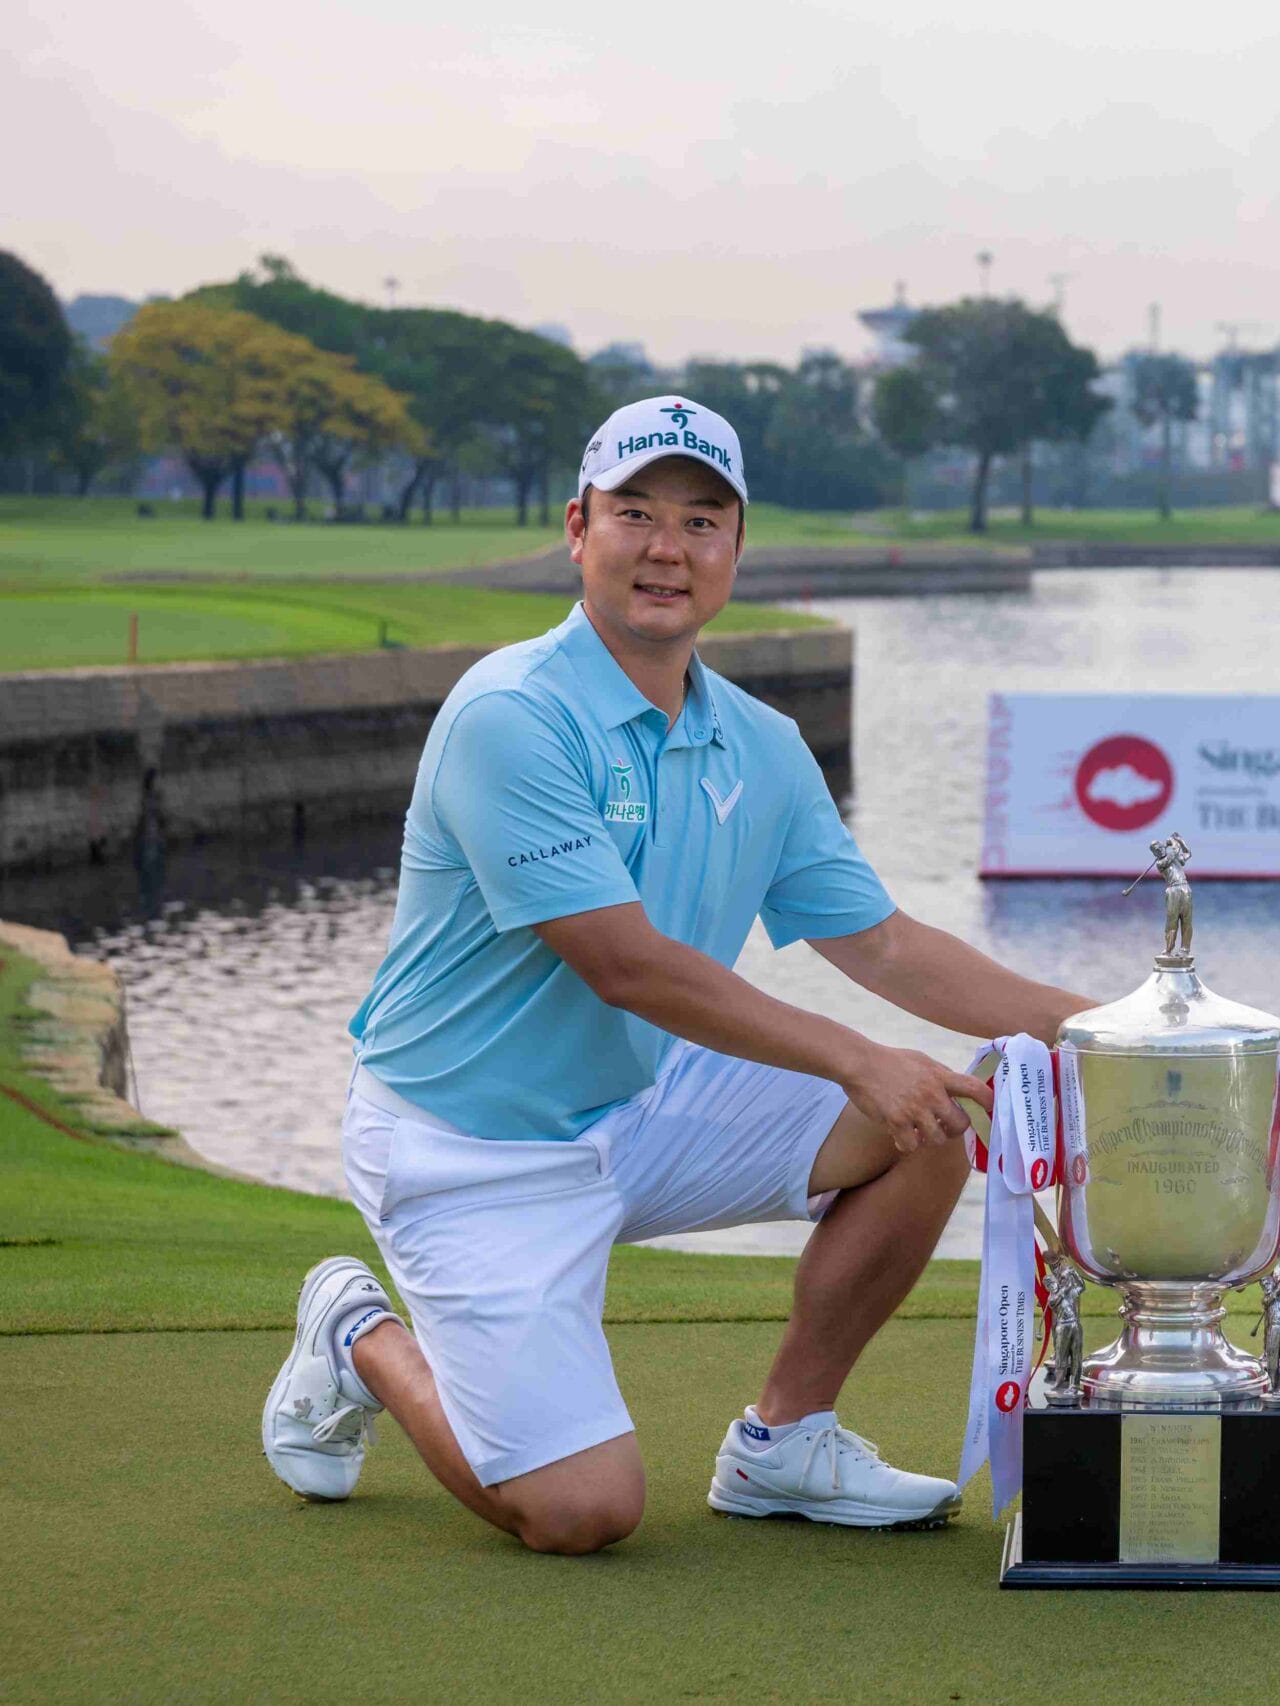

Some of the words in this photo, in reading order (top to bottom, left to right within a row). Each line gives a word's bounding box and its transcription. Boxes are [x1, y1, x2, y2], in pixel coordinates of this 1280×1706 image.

[618, 432, 680, 460] Hana
[683, 430, 733, 473] Bank
[604, 802, 647, 823] 하나은행
[1197, 801, 1247, 830] THE
[507, 835, 594, 868] CALLAWAY
[1019, 1063, 1031, 1094] Open
[1036, 1068, 1046, 1095] TIMES
[1024, 1096, 1037, 1152] Singapore
[1039, 1096, 1049, 1134] BUSINESS
[1042, 1134, 1050, 1152] THE
[1131, 1116, 1229, 1148] Championship
[1127, 1161, 1221, 1174] INAUGURATED
[1154, 1179, 1198, 1195] 1960
[999, 1285, 1011, 1319] Open
[1016, 1291, 1025, 1317] TIMES
[999, 1319, 1011, 1376] Singapore
[1016, 1318, 1025, 1356] BUSINESS
[1015, 1356, 1024, 1375] THE
